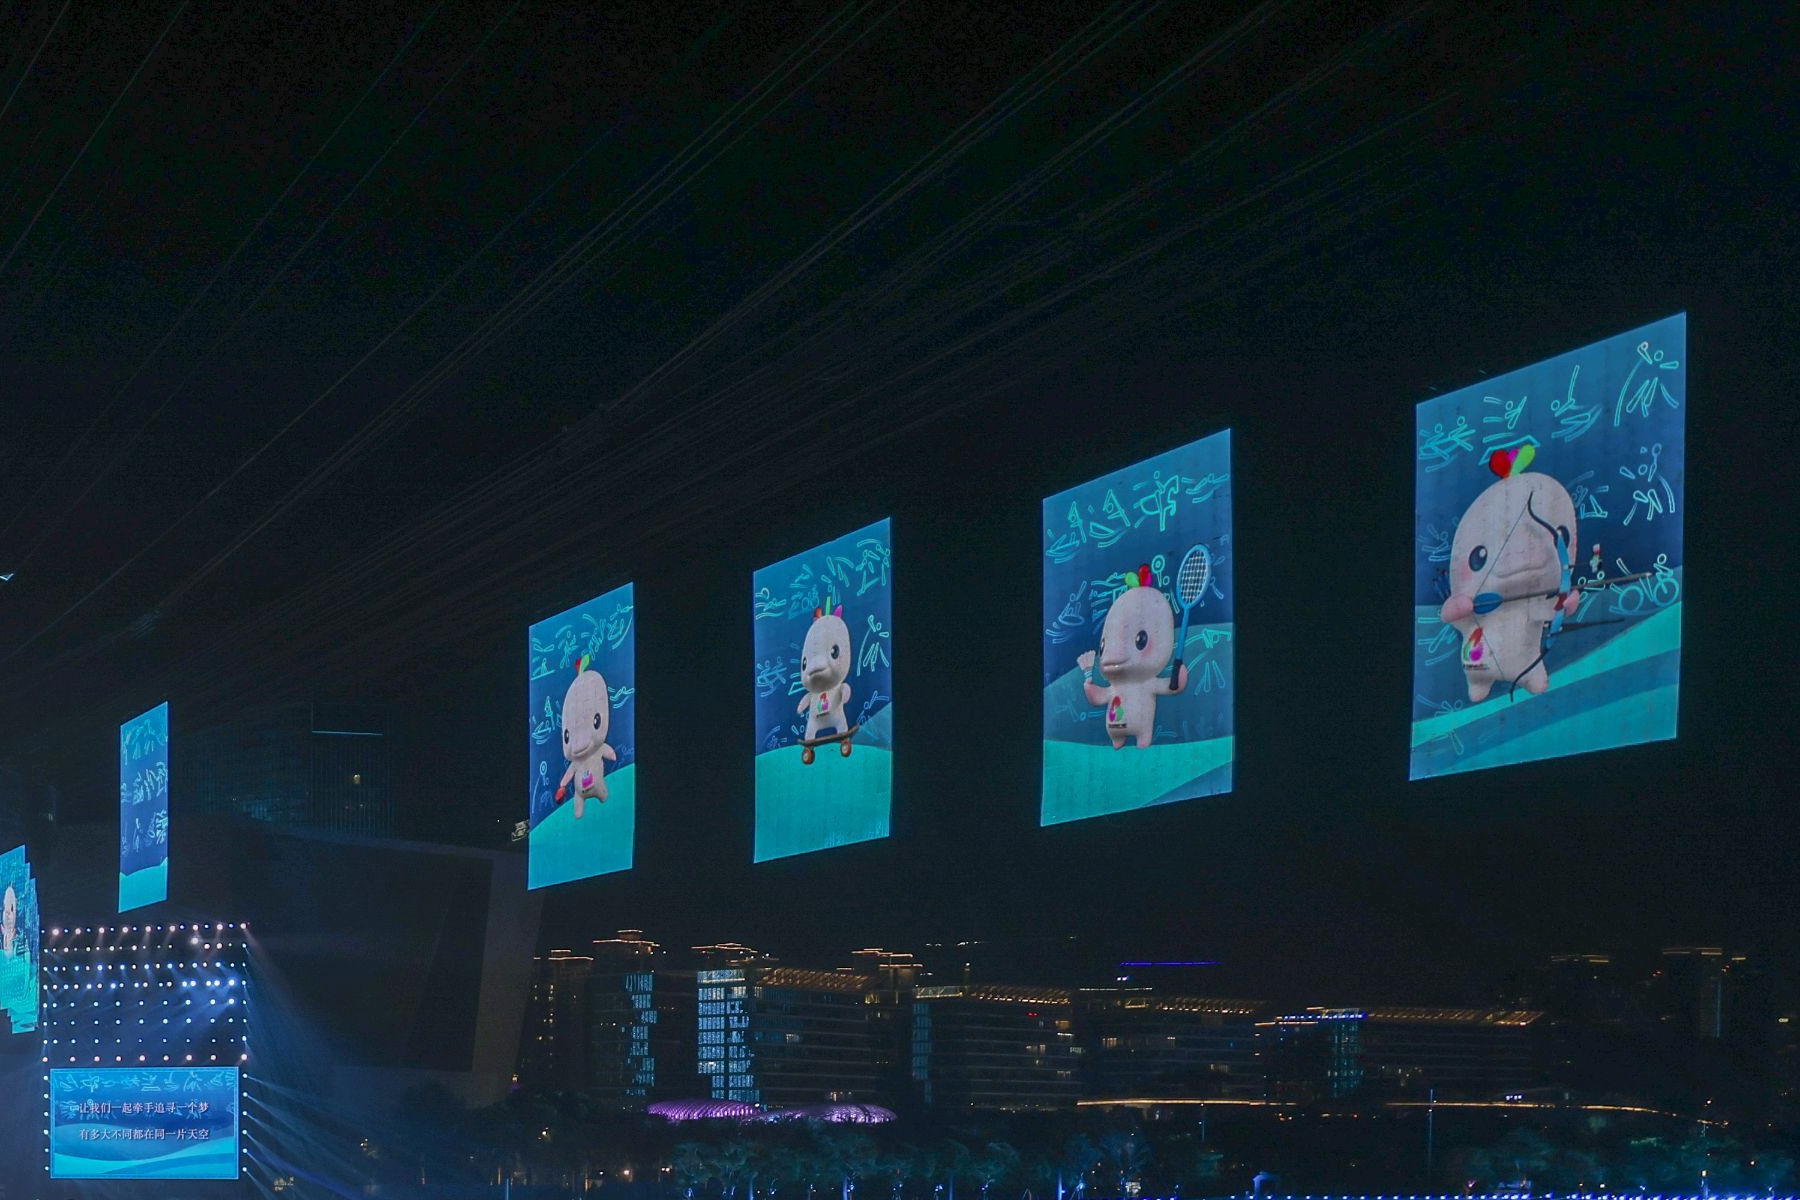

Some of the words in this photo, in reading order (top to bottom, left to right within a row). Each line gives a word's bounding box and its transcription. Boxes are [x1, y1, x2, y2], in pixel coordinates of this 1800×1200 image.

[79, 1102, 209, 1114] 让我们一起牵手追寻一个梦
[80, 1128, 209, 1140] 有多大不同都在同一片天空
